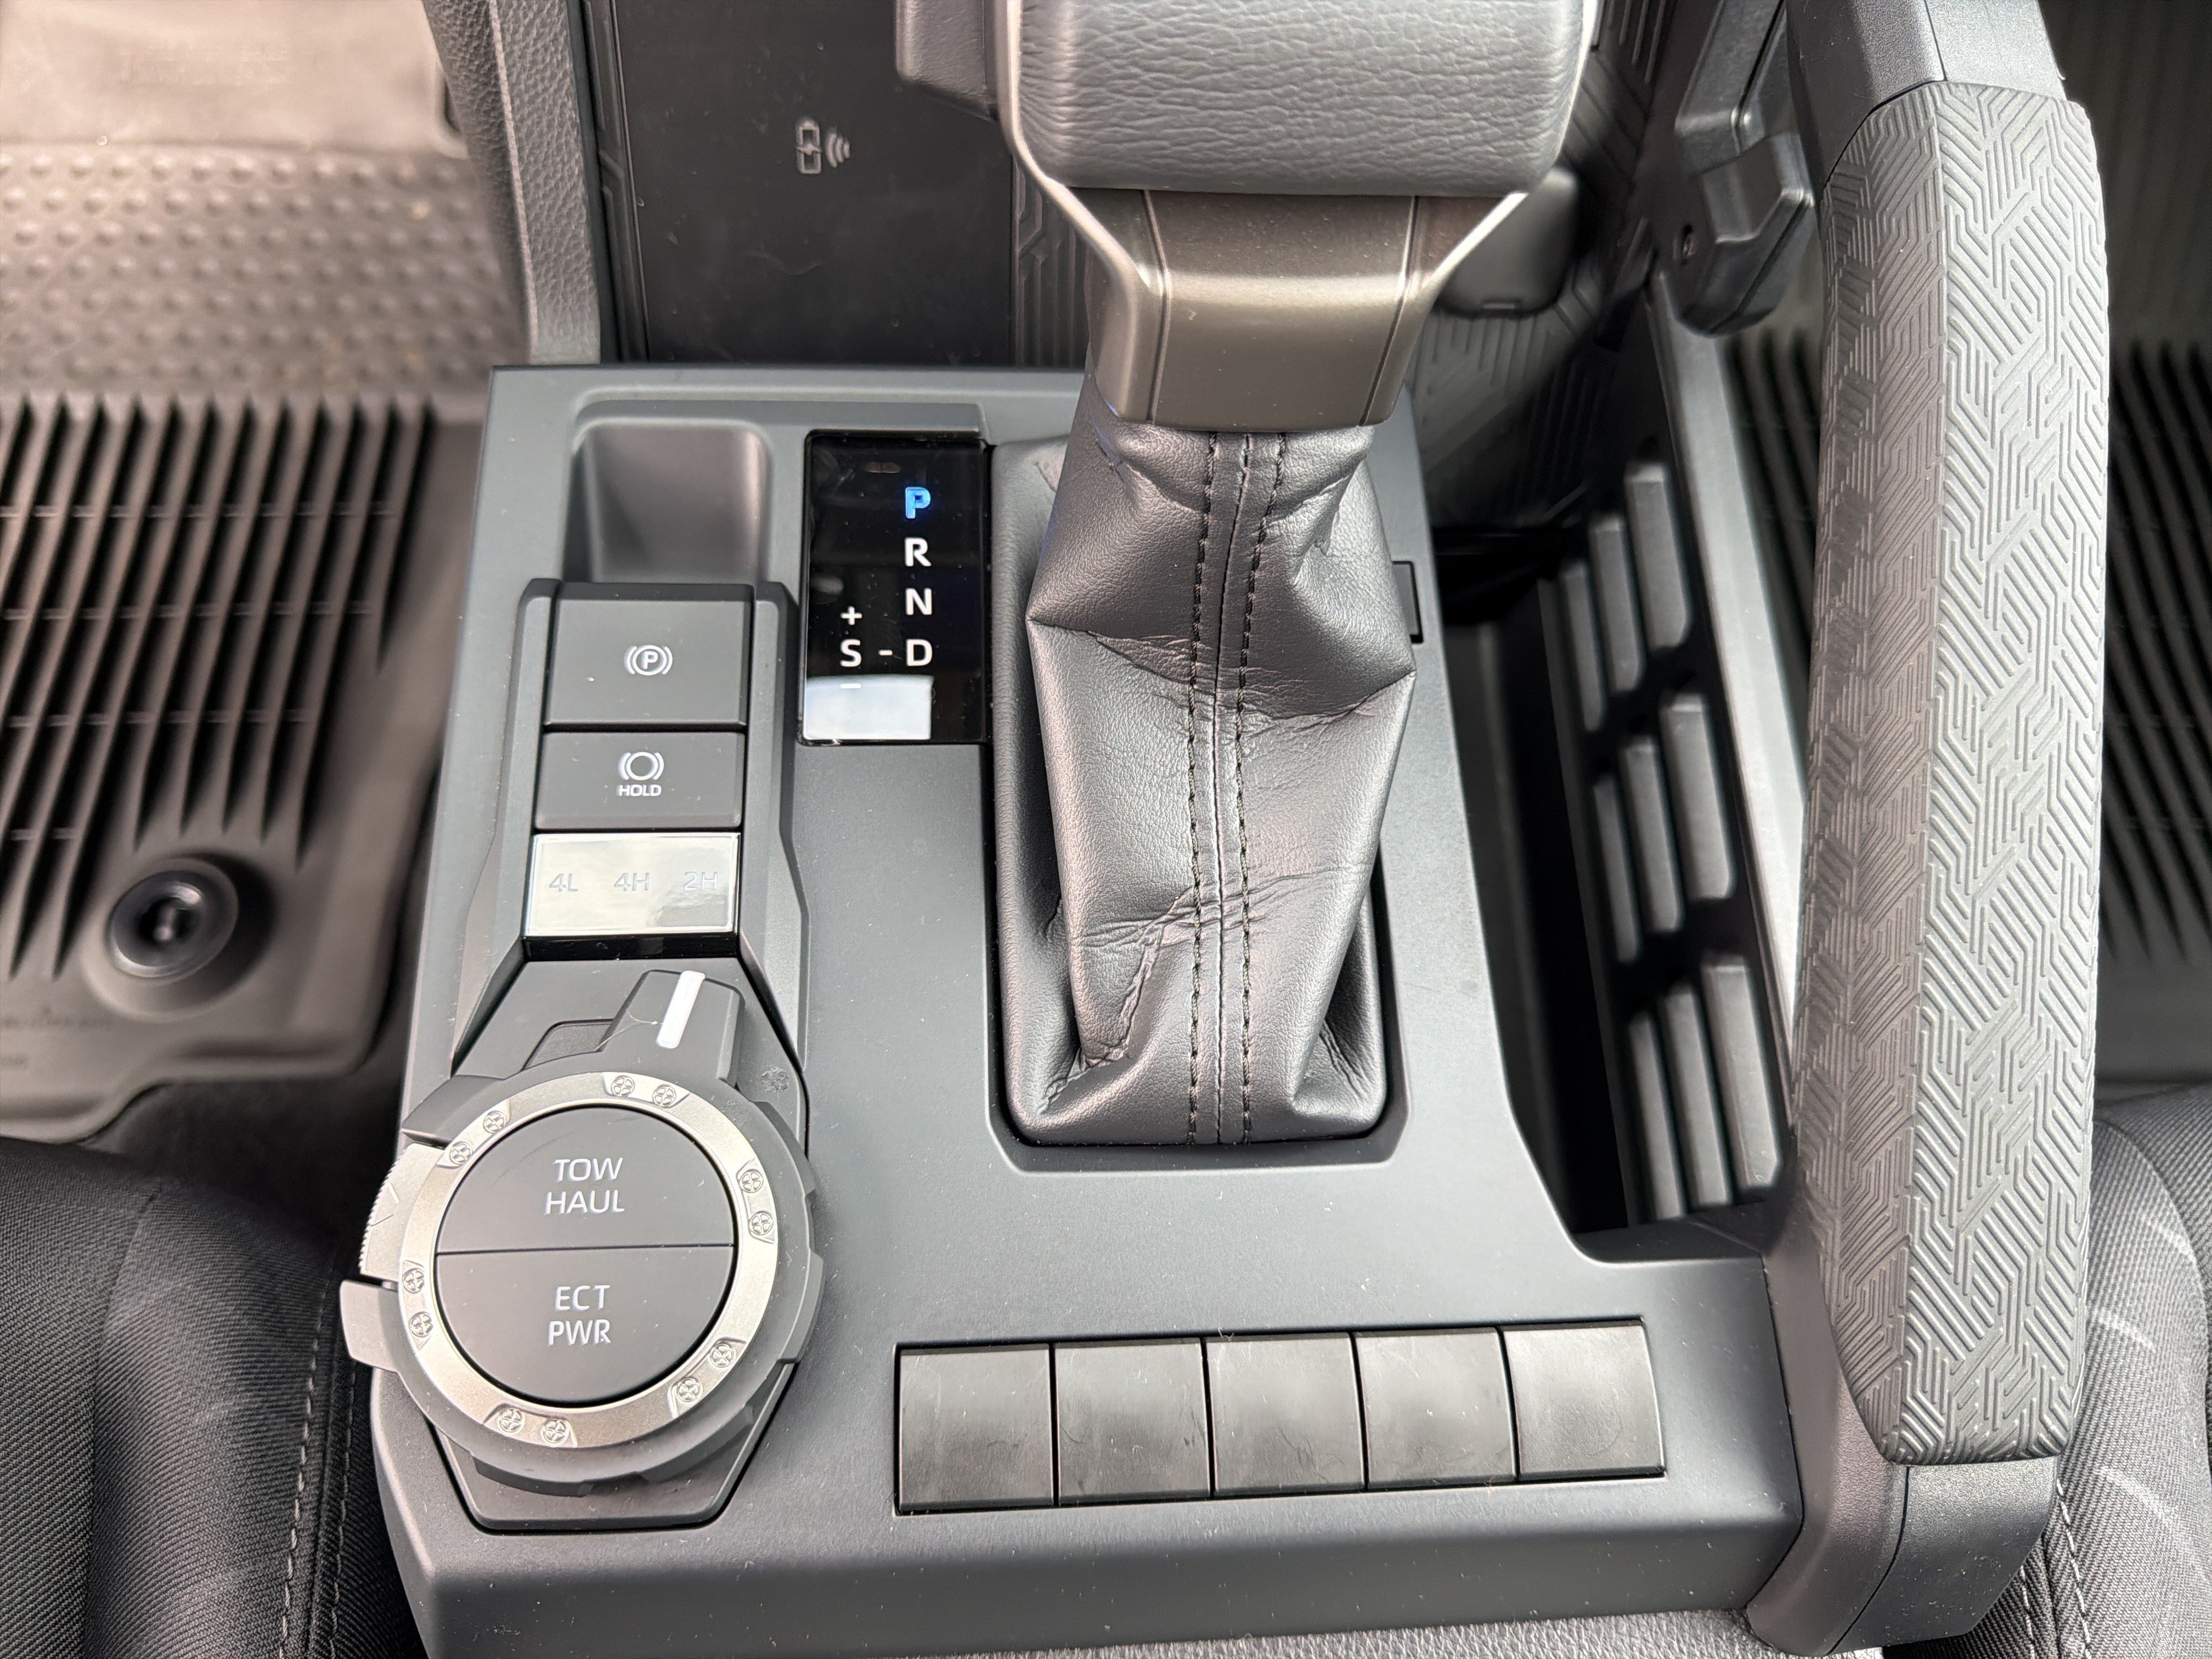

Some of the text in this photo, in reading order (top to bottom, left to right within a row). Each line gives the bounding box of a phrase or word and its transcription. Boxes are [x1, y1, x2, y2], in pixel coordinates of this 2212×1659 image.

[905, 486, 932, 519] P
[904, 537, 932, 567] R
[905, 588, 933, 616] N
[640, 650, 658, 670] P
[840, 639, 862, 668] S
[906, 639, 933, 667] D
[618, 784, 662, 797] HOLD
[549, 871, 718, 893] 4L 4H 2H
[552, 1157, 624, 1182] TOW
[544, 1189, 625, 1216] HAUL
[555, 1284, 611, 1311] ECT
[548, 1319, 612, 1347] PWR
